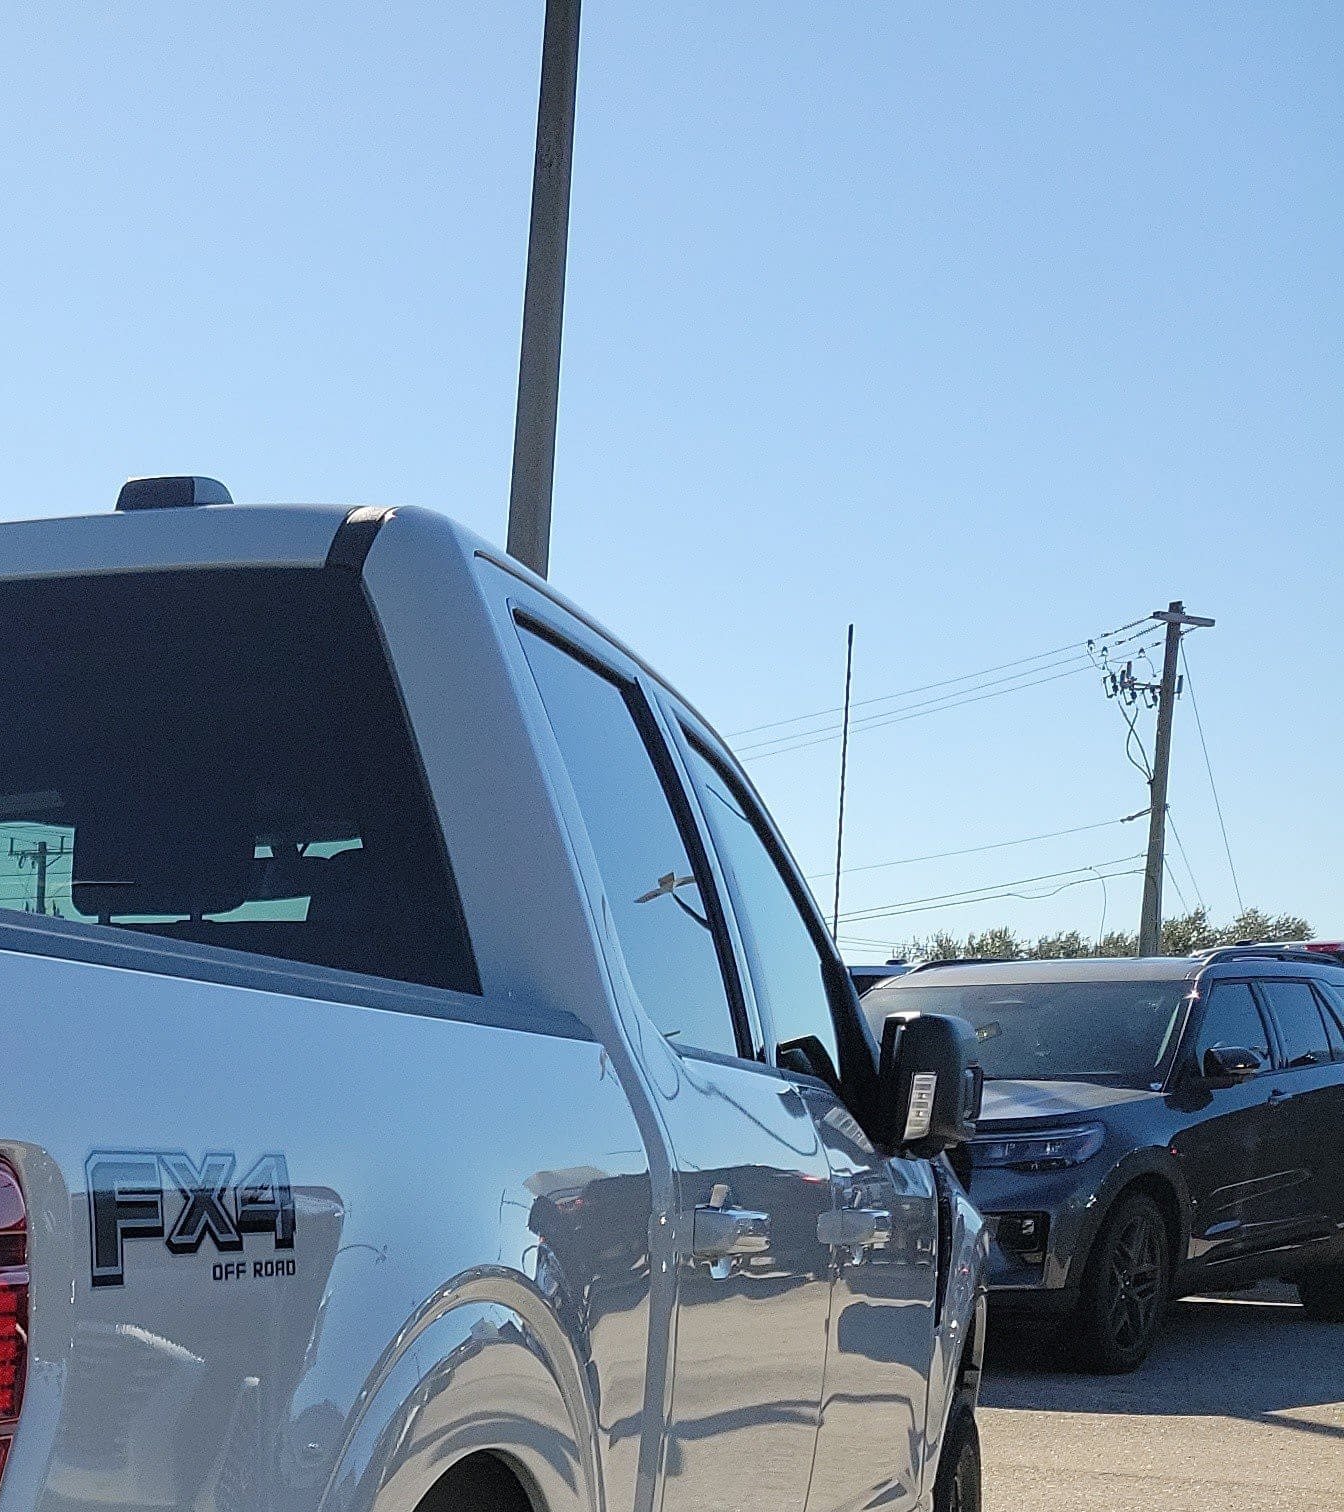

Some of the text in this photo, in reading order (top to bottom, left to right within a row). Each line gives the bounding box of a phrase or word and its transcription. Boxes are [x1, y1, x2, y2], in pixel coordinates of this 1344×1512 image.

[85, 1149, 297, 1289] FX4
[212, 1259, 297, 1282] OFF ROAD
